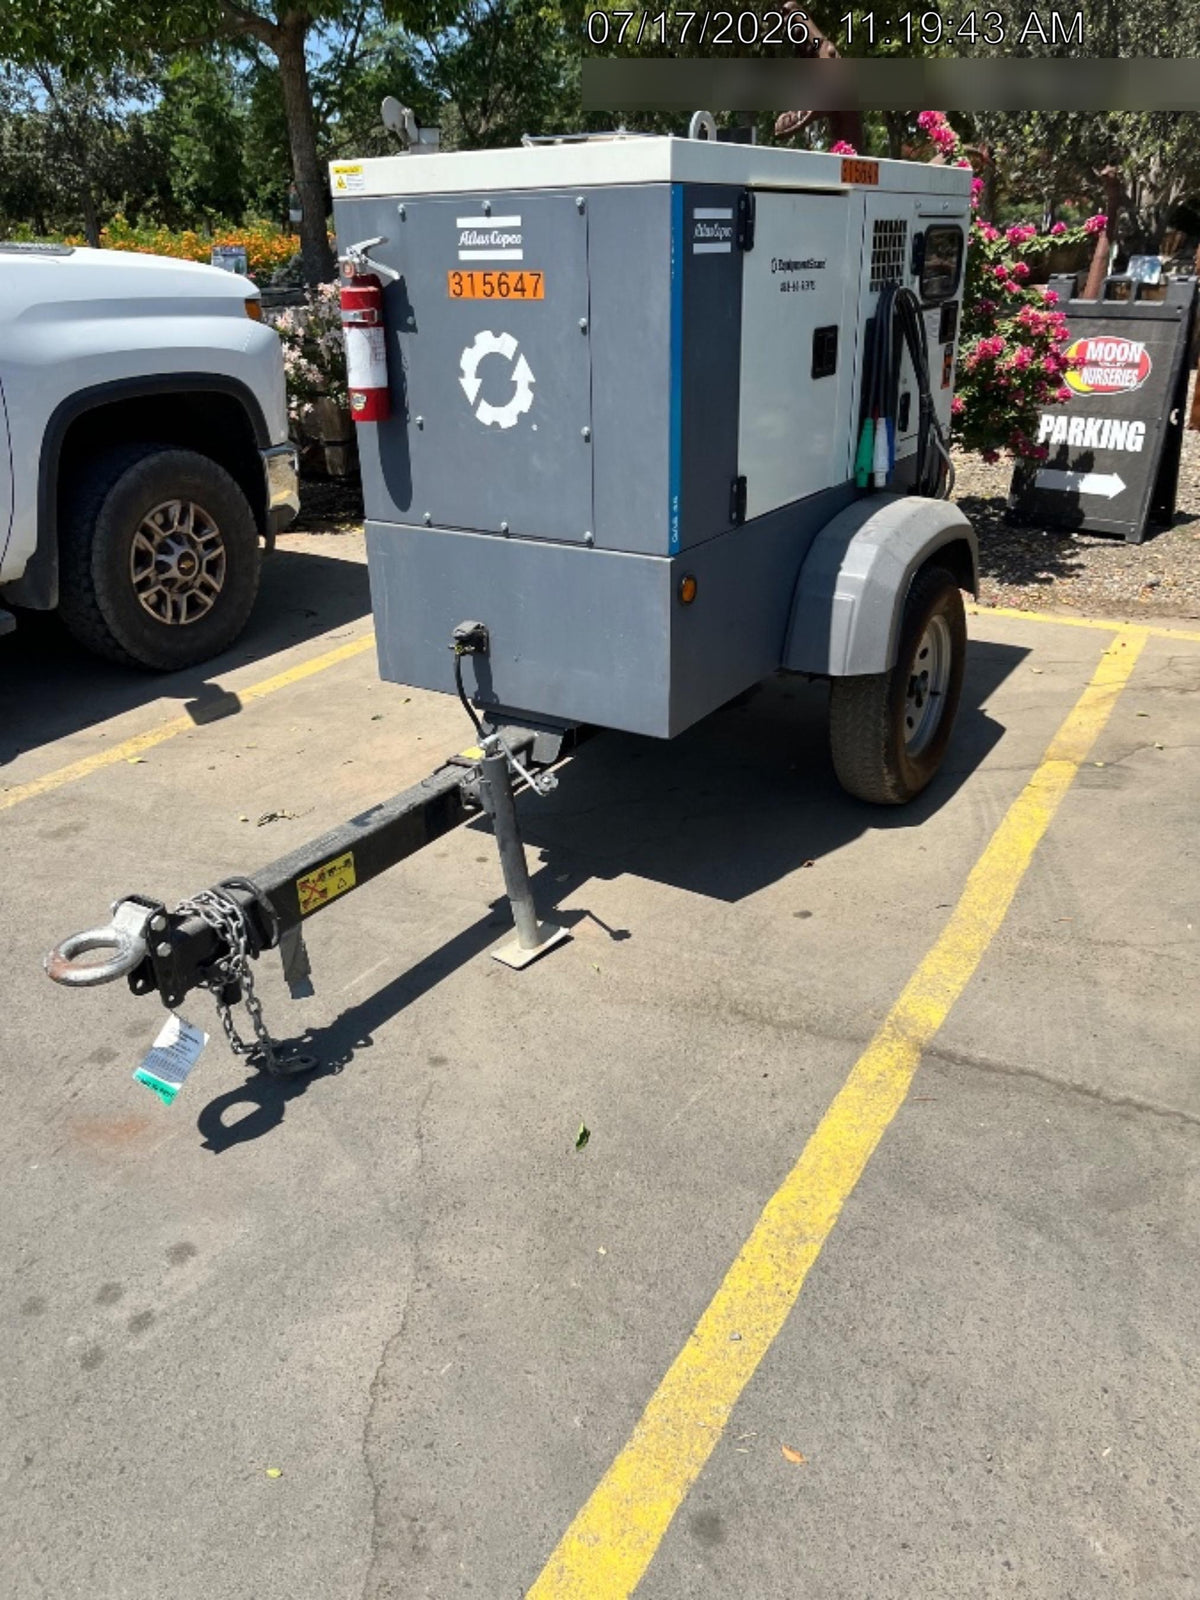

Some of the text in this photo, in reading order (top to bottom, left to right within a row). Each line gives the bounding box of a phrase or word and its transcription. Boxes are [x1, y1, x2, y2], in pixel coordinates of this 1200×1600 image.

[458, 230, 522, 248] Atlas Copco
[452, 271, 542, 298] 315647
[1086, 341, 1145, 363] MOON
[1081, 367, 1138, 388] NURSERIES
[1037, 414, 1146, 452] PARKING
